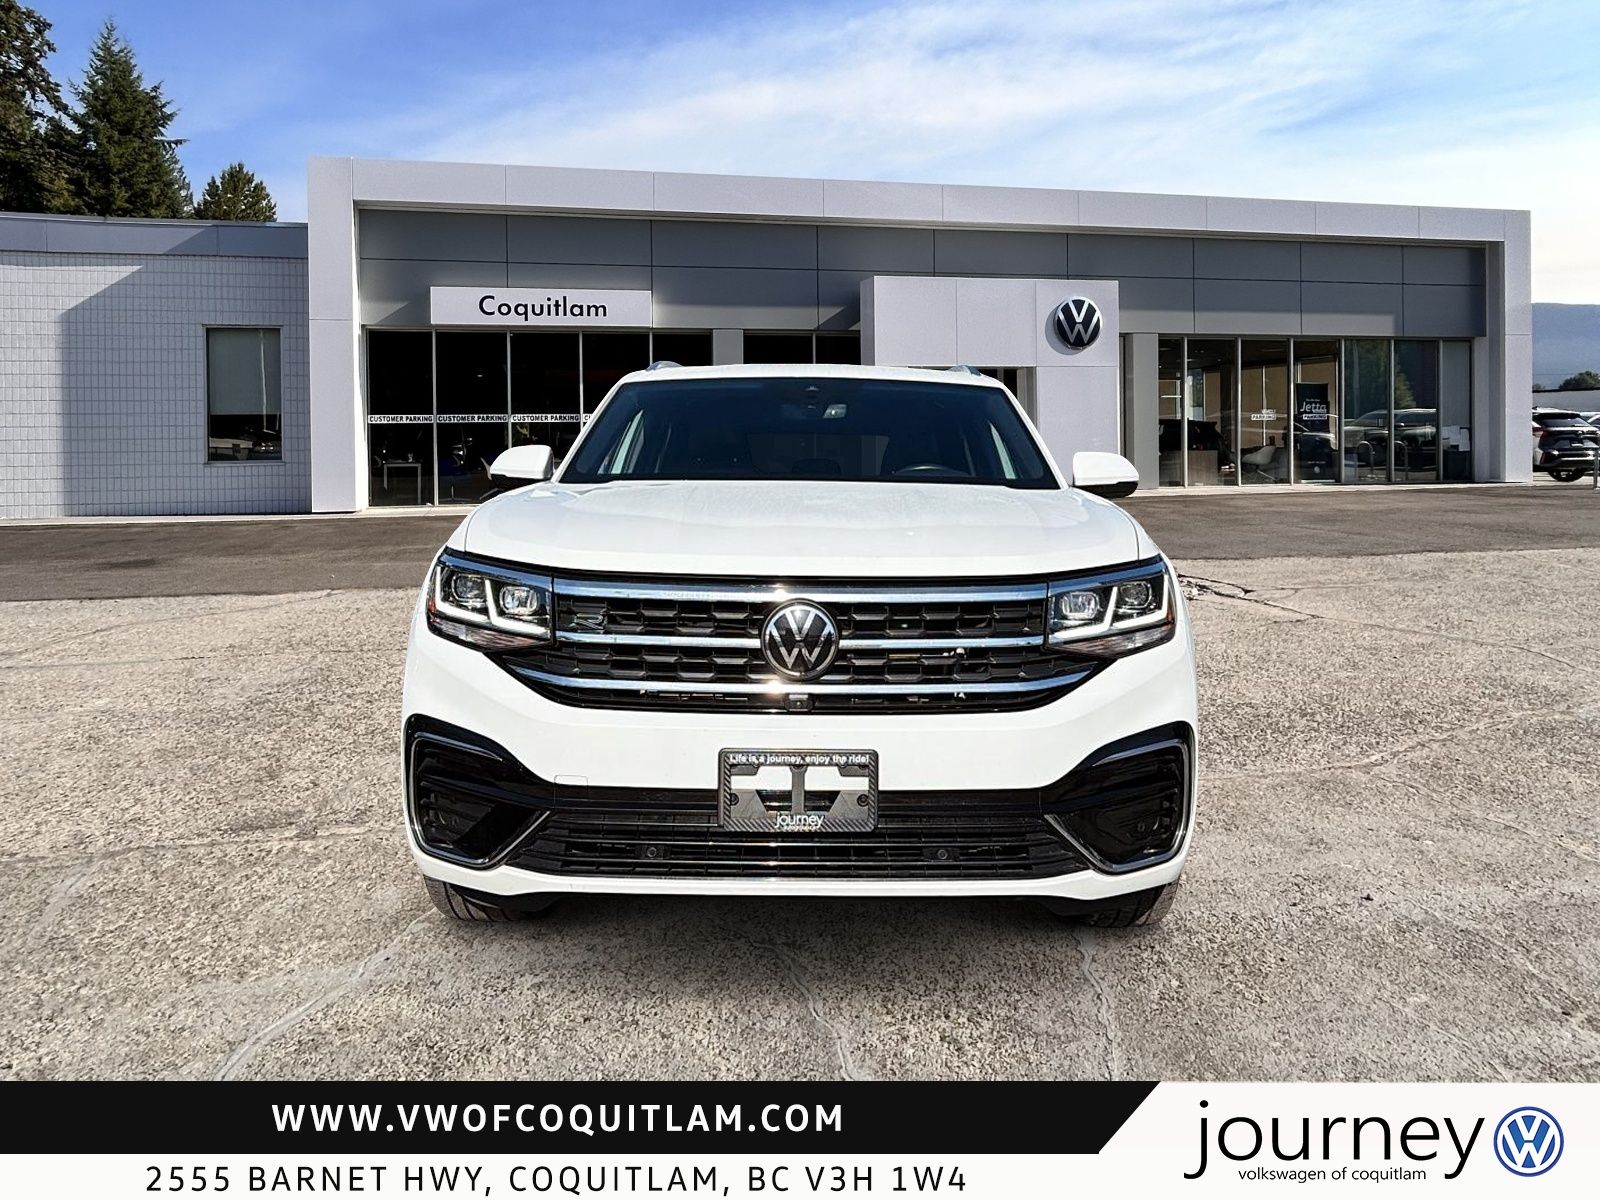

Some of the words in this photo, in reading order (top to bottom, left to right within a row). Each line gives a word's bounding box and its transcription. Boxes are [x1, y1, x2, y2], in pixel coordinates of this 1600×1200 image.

[478, 295, 607, 321] Coquitlam
[1300, 401, 1327, 412] Jetta
[730, 754, 747, 762] Life
[805, 754, 830, 764] enjoy
[832, 754, 847, 763] the
[775, 812, 825, 828] journey
